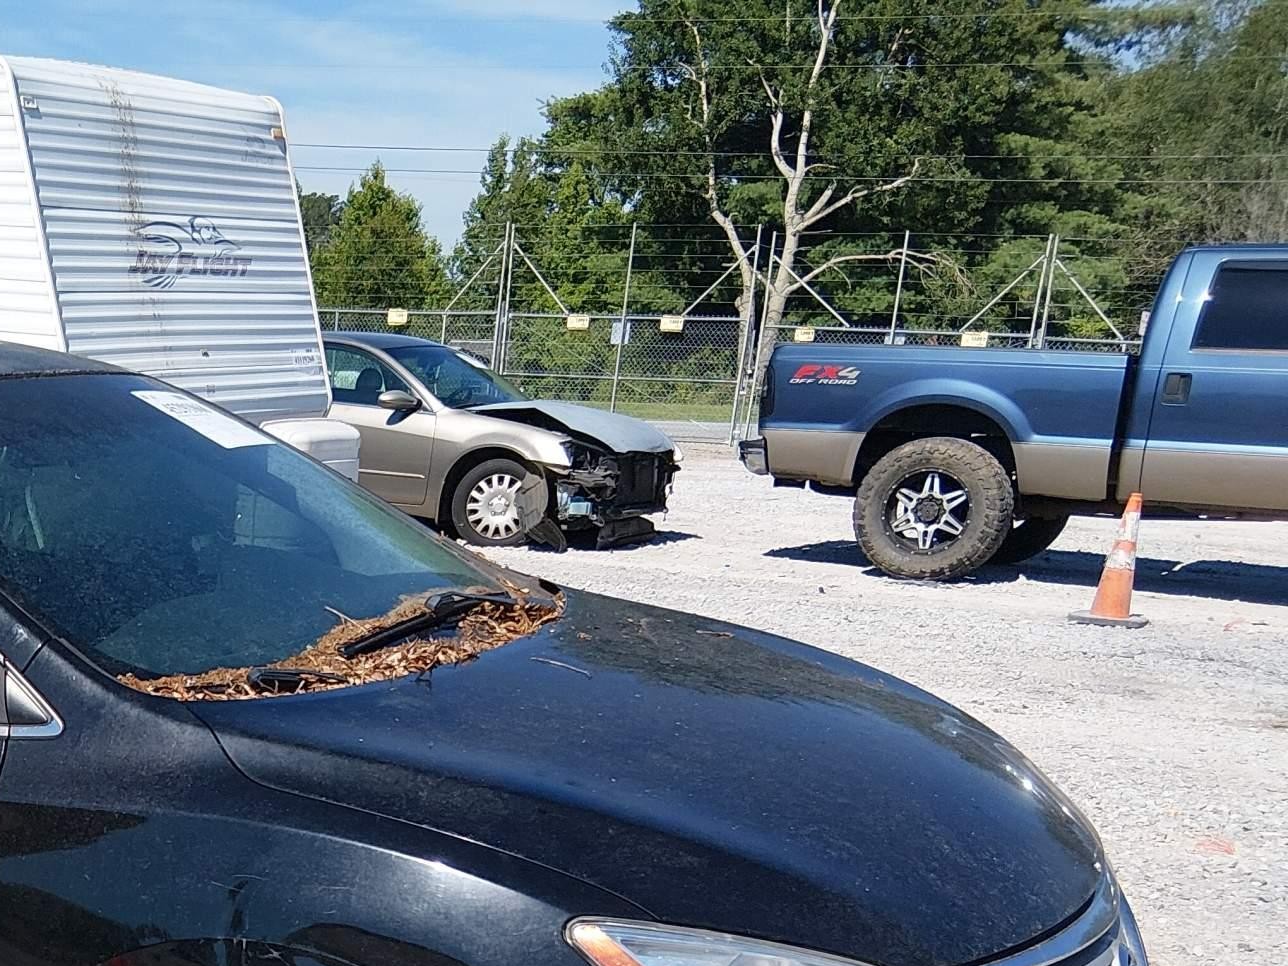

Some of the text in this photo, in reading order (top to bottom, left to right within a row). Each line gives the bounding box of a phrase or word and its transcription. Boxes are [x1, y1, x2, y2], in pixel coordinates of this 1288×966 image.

[128, 250, 252, 277] JAY FLIGHT
[793, 365, 862, 379] FX4
